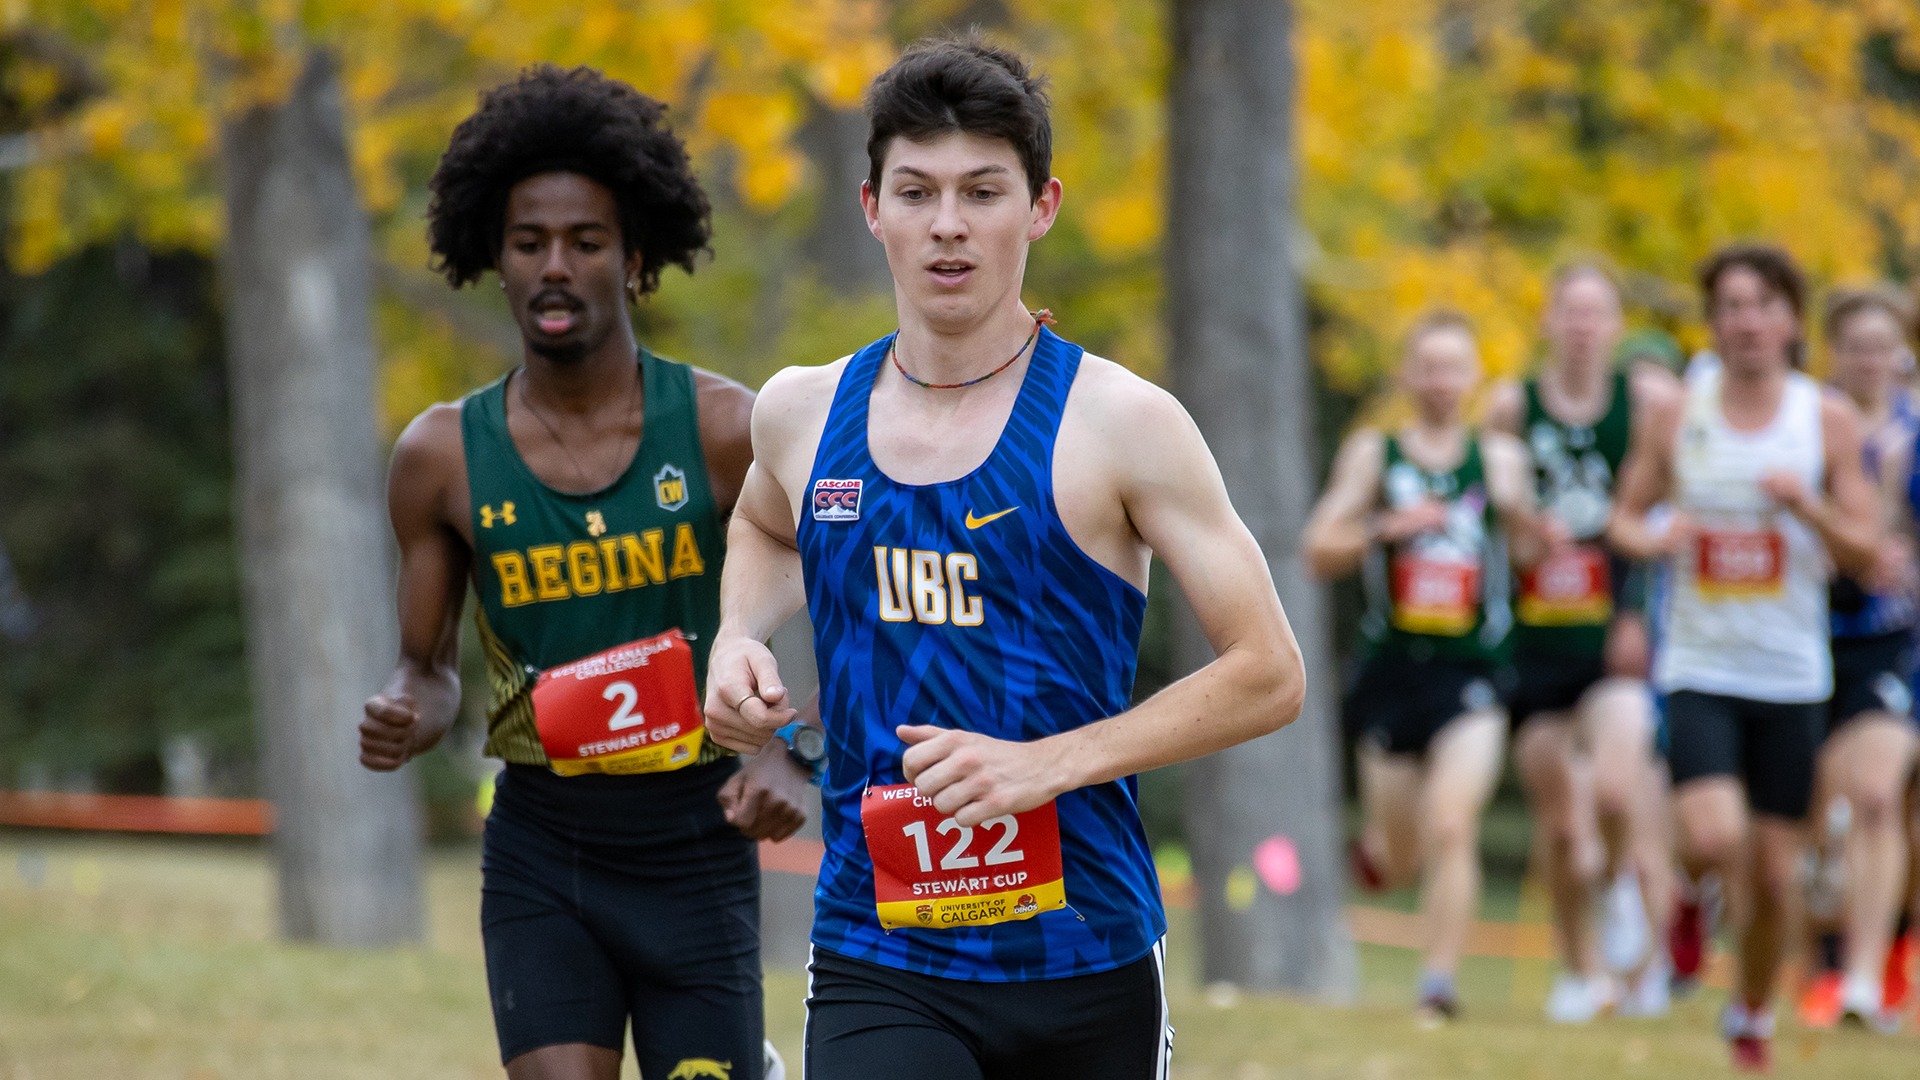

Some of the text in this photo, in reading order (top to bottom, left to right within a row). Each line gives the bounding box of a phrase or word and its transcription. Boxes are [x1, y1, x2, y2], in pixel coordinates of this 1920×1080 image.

[816, 481, 861, 489] CASCADE
[815, 491, 858, 508] CCC
[491, 522, 705, 608] REGINA
[873, 546, 985, 627] UBC
[602, 681, 645, 732] 2
[578, 722, 681, 757] STEWART CUP
[882, 787, 919, 801] WEST
[902, 814, 1025, 873] 122
[912, 871, 1028, 895] STEWART CUP
[940, 898, 1006, 912] UNIVERSITY OF
[940, 906, 1007, 924] CALGARY
[1014, 903, 1039, 915] DINOS
